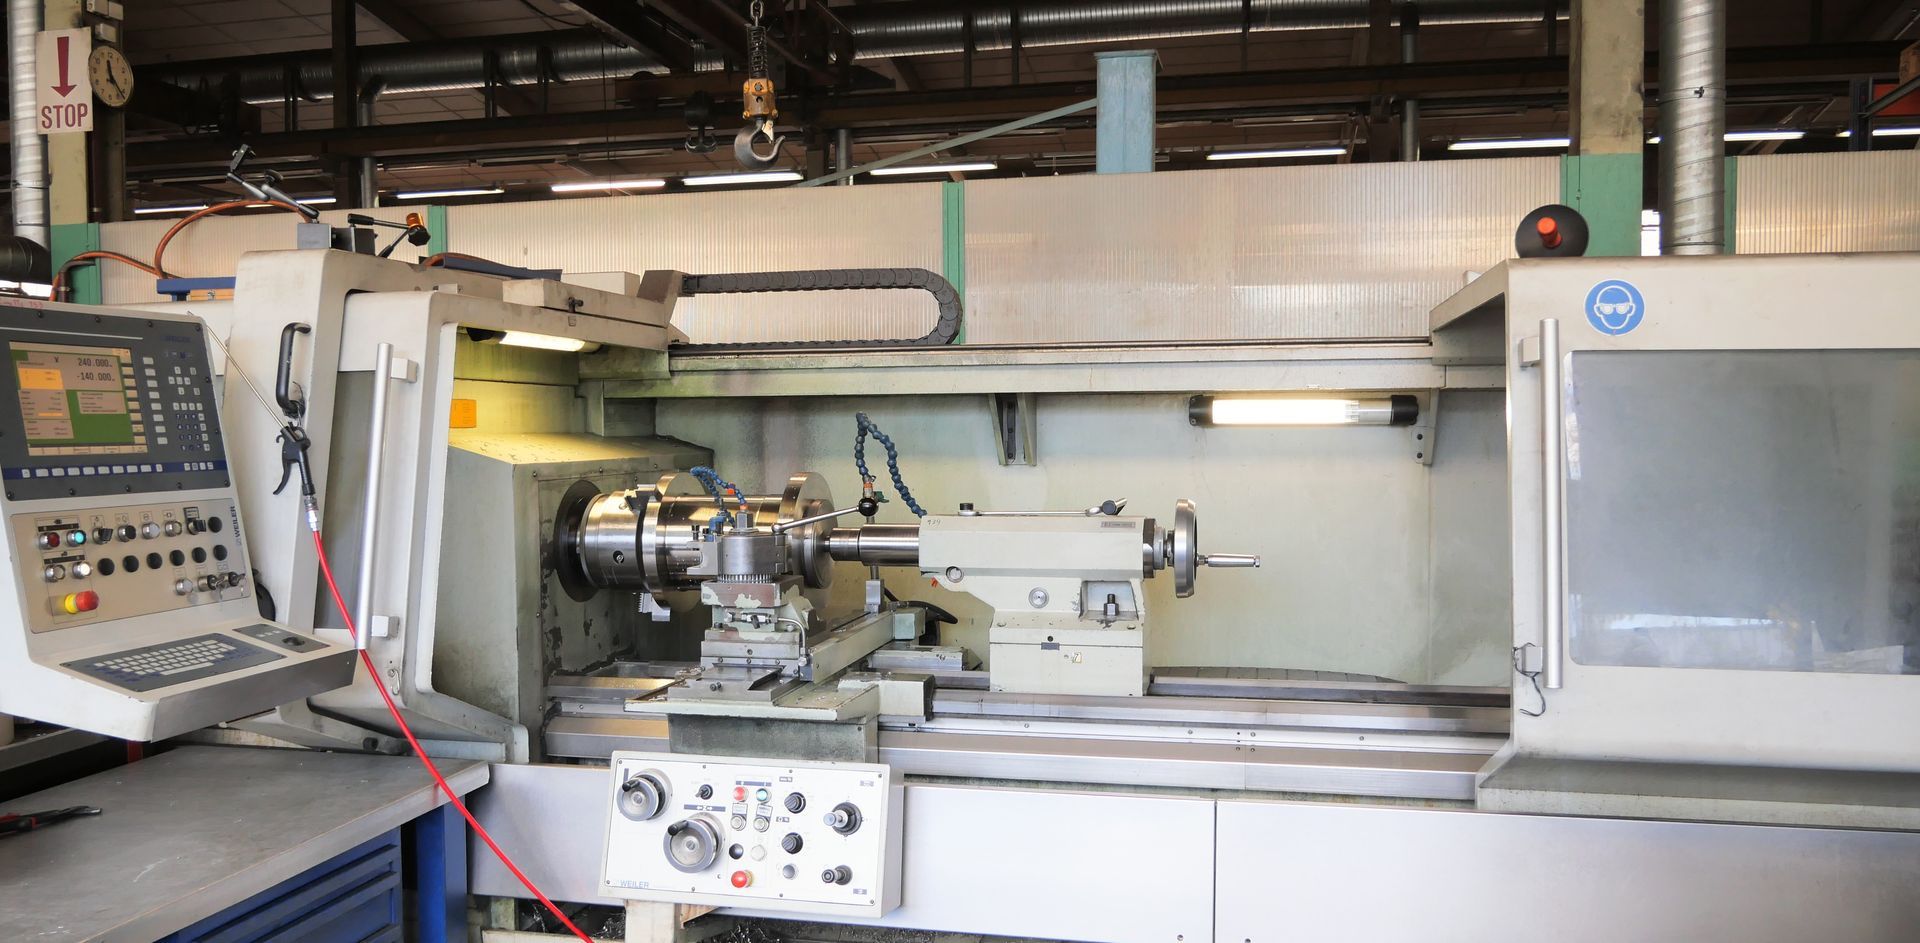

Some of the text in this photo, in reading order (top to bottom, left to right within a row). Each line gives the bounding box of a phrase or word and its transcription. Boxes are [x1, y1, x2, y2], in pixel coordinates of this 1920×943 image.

[41, 103, 88, 129] STOP
[230, 506, 240, 538] WEILER
[620, 879, 649, 889] WEILER
